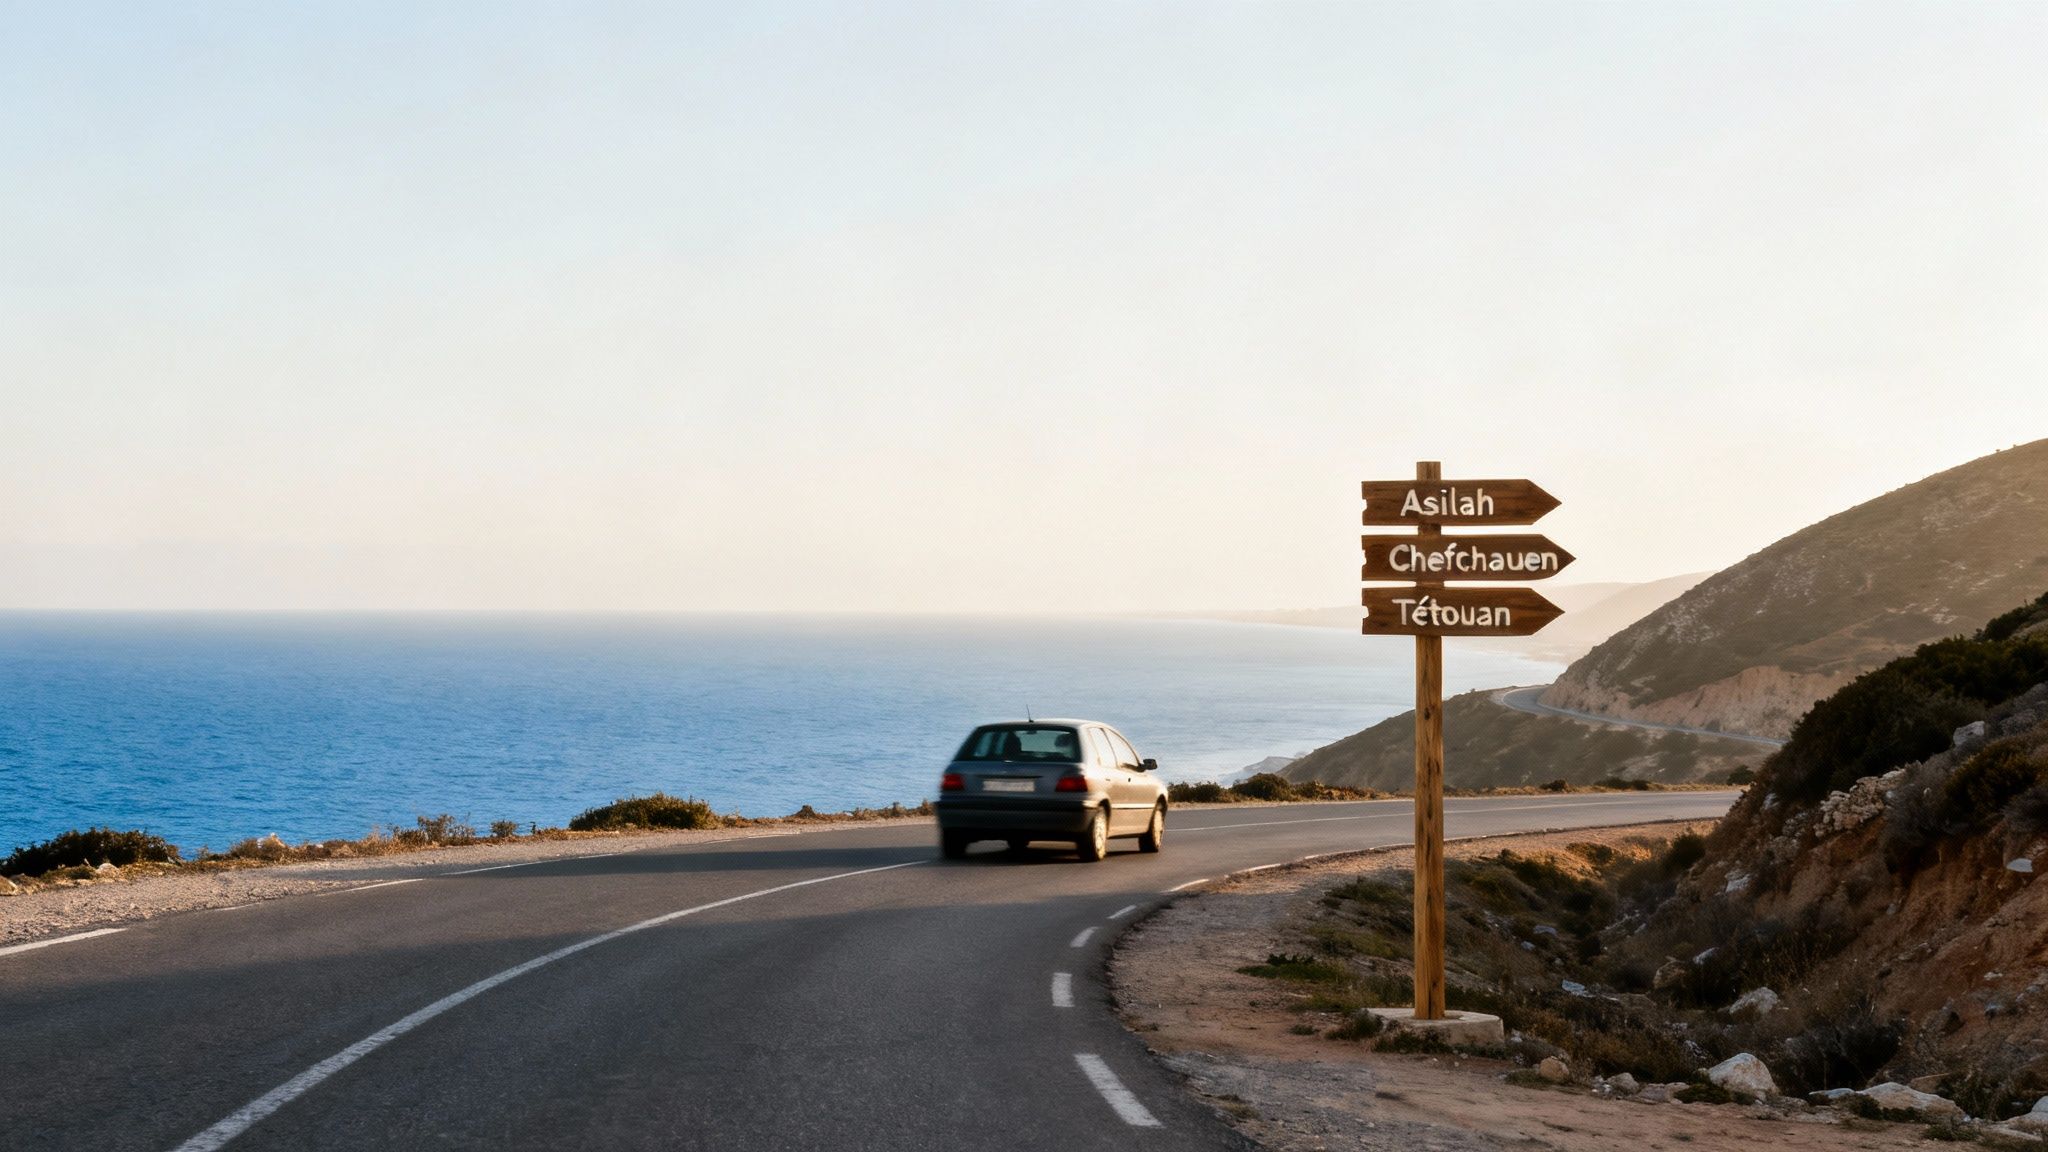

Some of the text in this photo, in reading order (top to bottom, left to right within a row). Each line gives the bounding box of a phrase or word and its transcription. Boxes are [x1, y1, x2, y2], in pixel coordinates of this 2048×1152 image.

[1400, 487, 1494, 517] Asilah
[1388, 542, 1559, 573] Chefchauen
[1392, 595, 1511, 626] Tétouan
